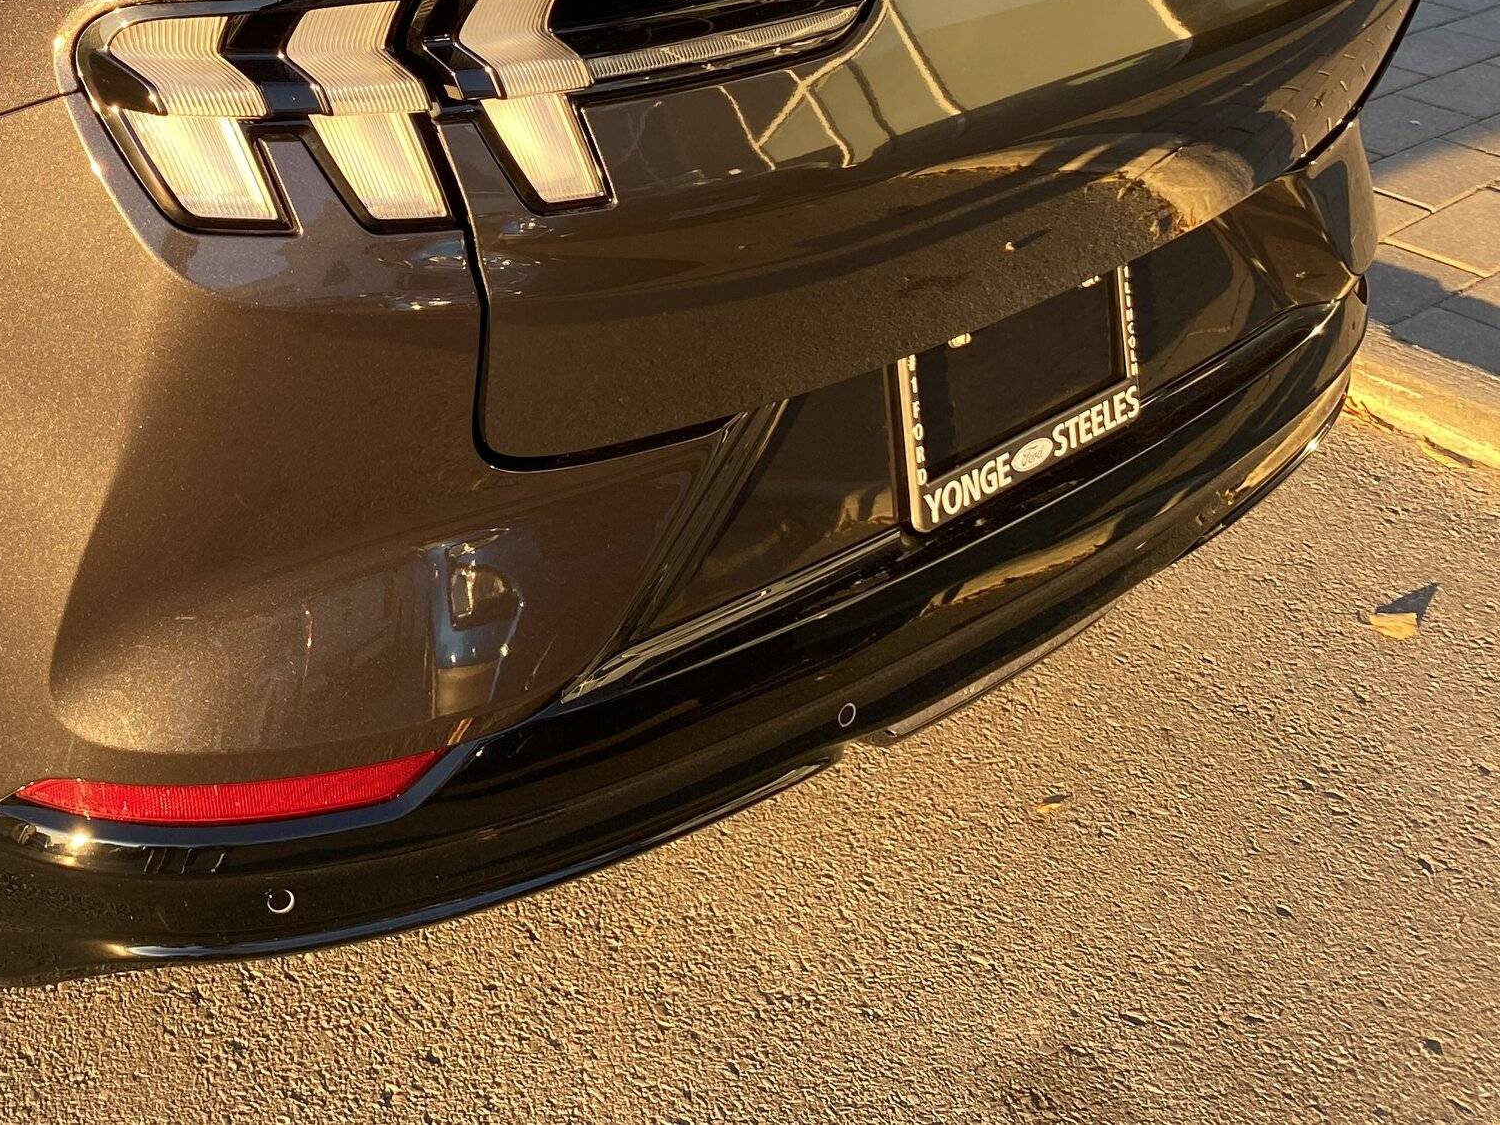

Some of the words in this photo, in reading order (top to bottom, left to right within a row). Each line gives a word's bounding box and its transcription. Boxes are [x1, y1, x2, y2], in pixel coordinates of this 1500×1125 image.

[1124, 281, 1139, 377] LINCOLN
[911, 400, 927, 487] FORD
[923, 451, 1013, 524] YONGE
[1051, 384, 1140, 458] STEELES
